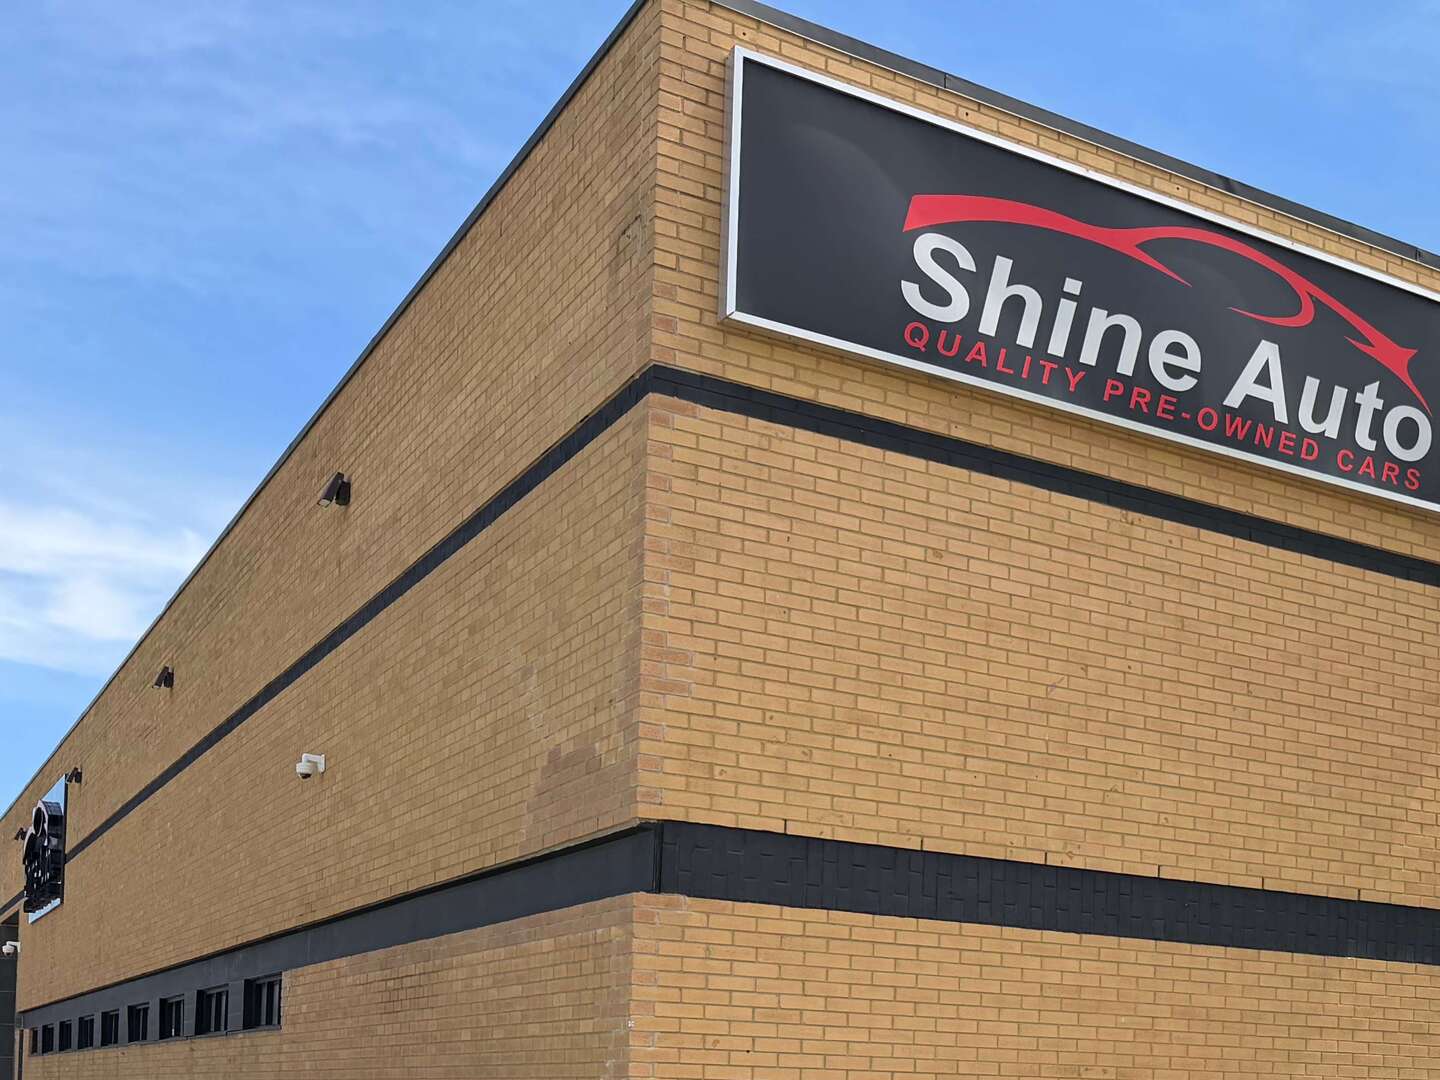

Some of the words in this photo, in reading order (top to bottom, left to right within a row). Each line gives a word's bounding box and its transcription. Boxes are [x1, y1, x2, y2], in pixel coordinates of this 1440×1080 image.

[900, 232, 1202, 392] Shine
[1222, 339, 1432, 462] Auto
[903, 320, 1085, 393] QUALITY
[1103, 378, 1319, 462] PRE-OWNED
[1336, 449, 1421, 492] CARS
